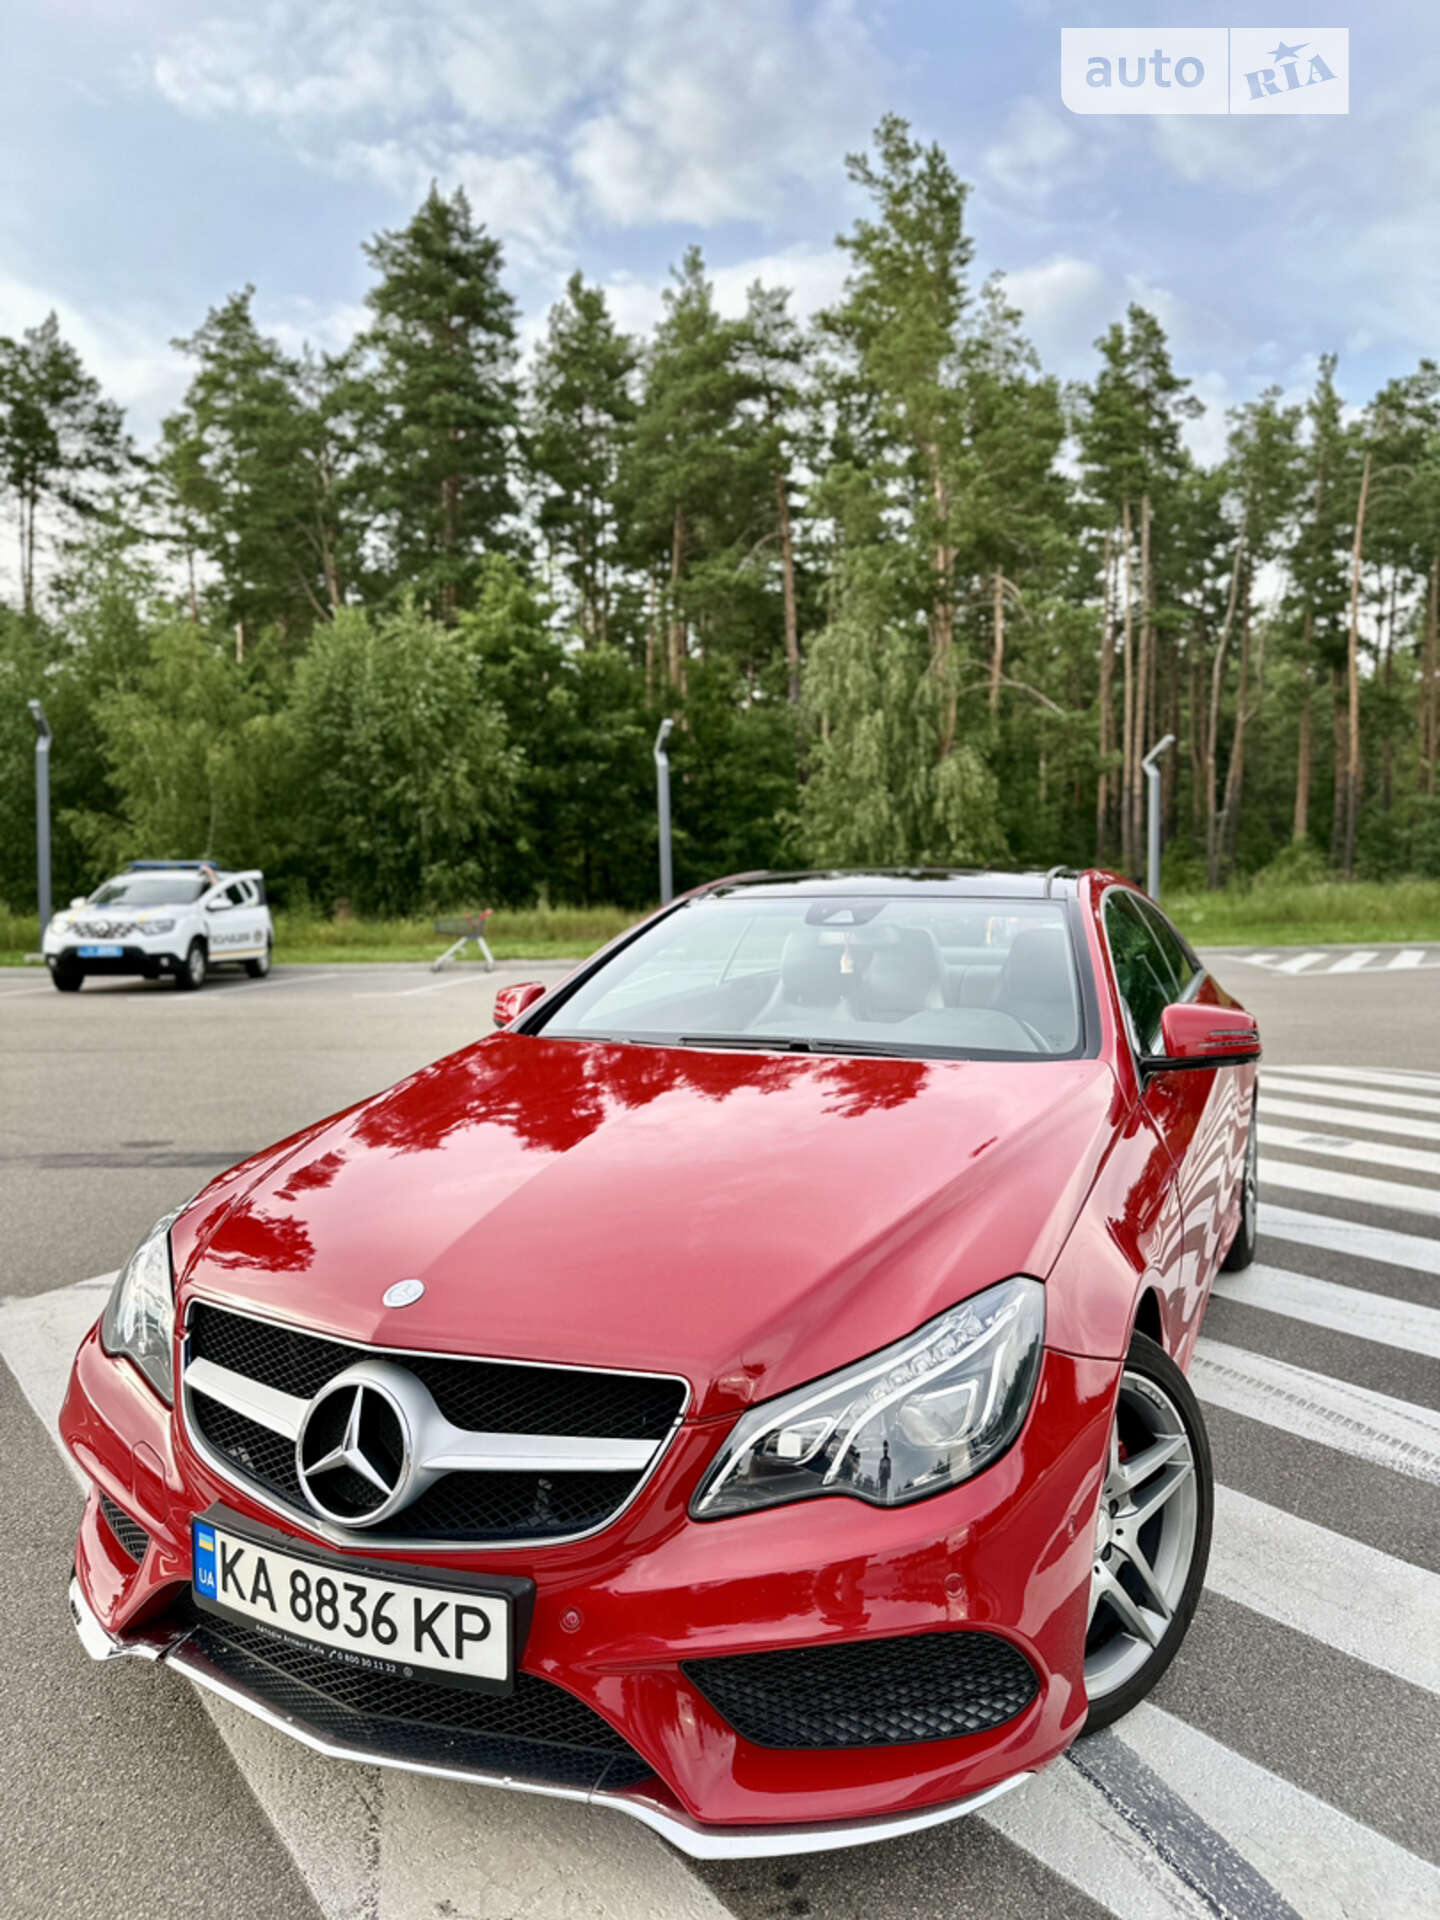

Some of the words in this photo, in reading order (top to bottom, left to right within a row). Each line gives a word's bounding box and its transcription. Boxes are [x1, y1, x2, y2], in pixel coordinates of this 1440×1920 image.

[199, 1567, 215, 1587] UA
[220, 1541, 277, 1613] KA
[289, 1569, 398, 1646] 8836
[413, 1597, 491, 1660] KP
